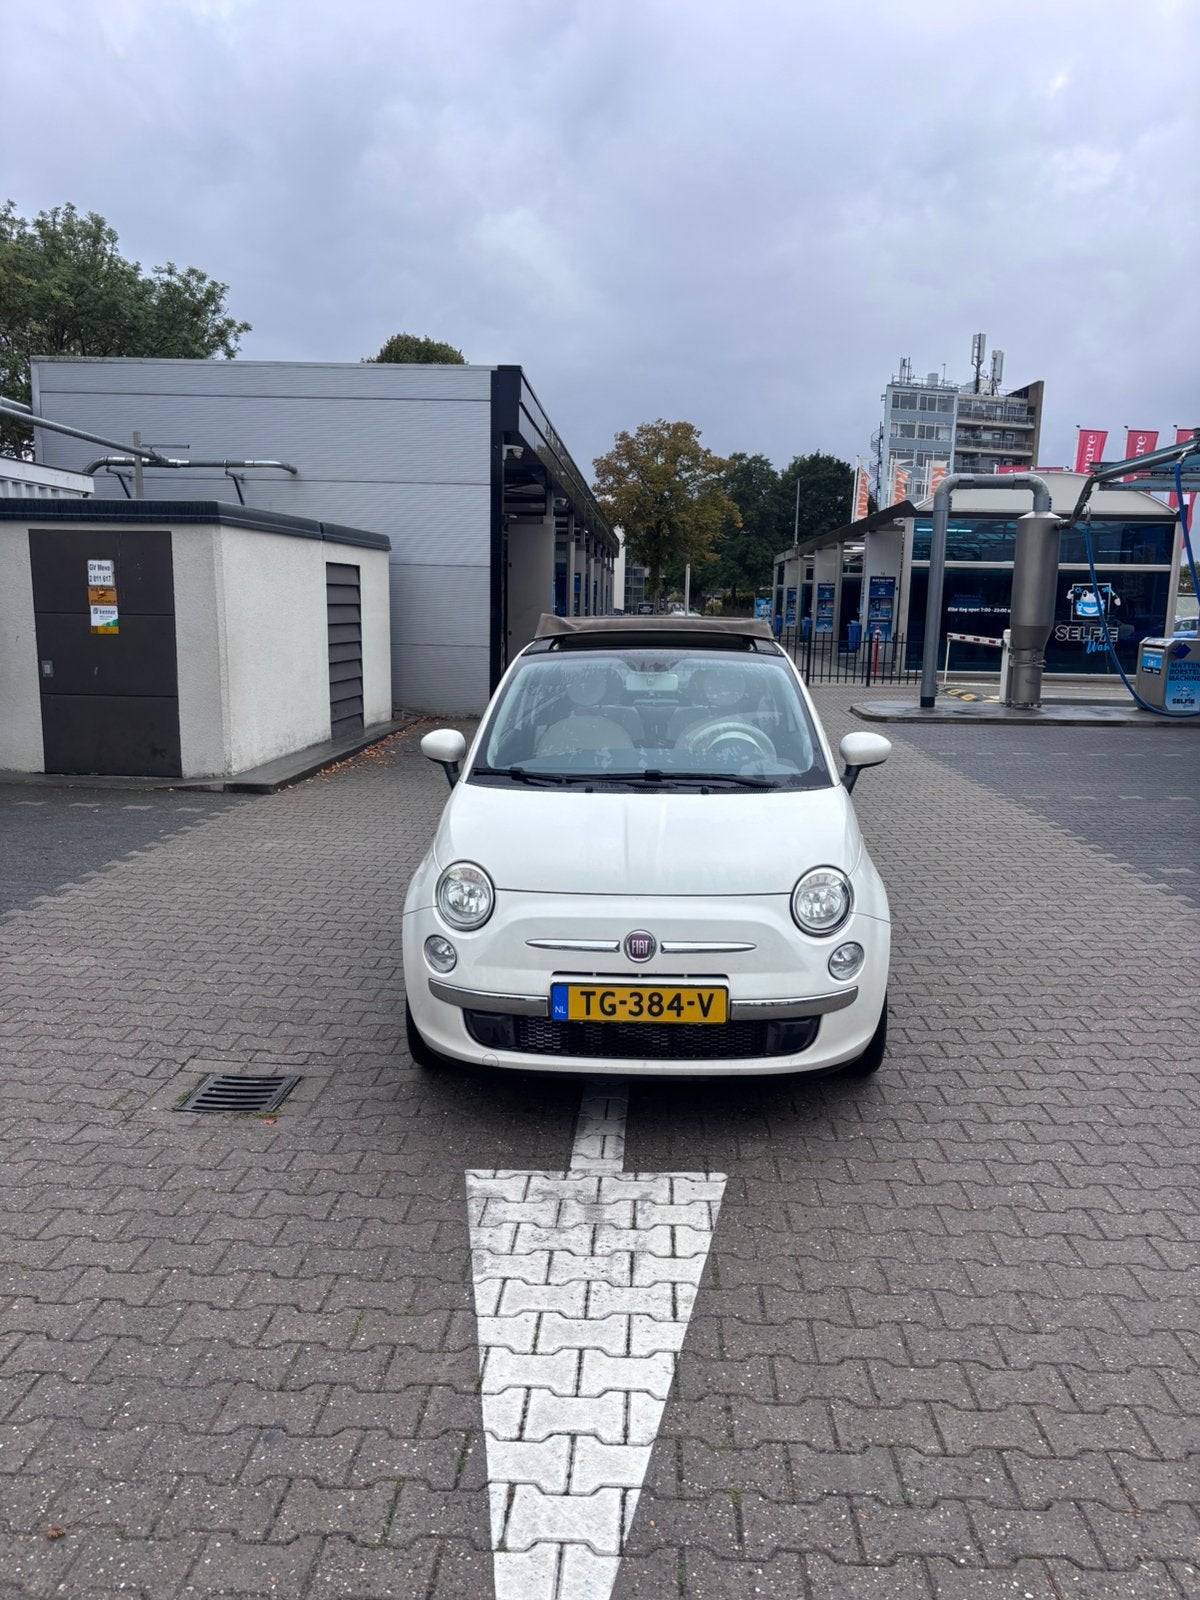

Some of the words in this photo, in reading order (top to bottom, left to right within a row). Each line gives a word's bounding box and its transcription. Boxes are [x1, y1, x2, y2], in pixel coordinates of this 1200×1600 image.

[631, 939, 650, 955] FIAT
[555, 1005, 566, 1014] NL
[579, 990, 715, 1019] TG-384-V
